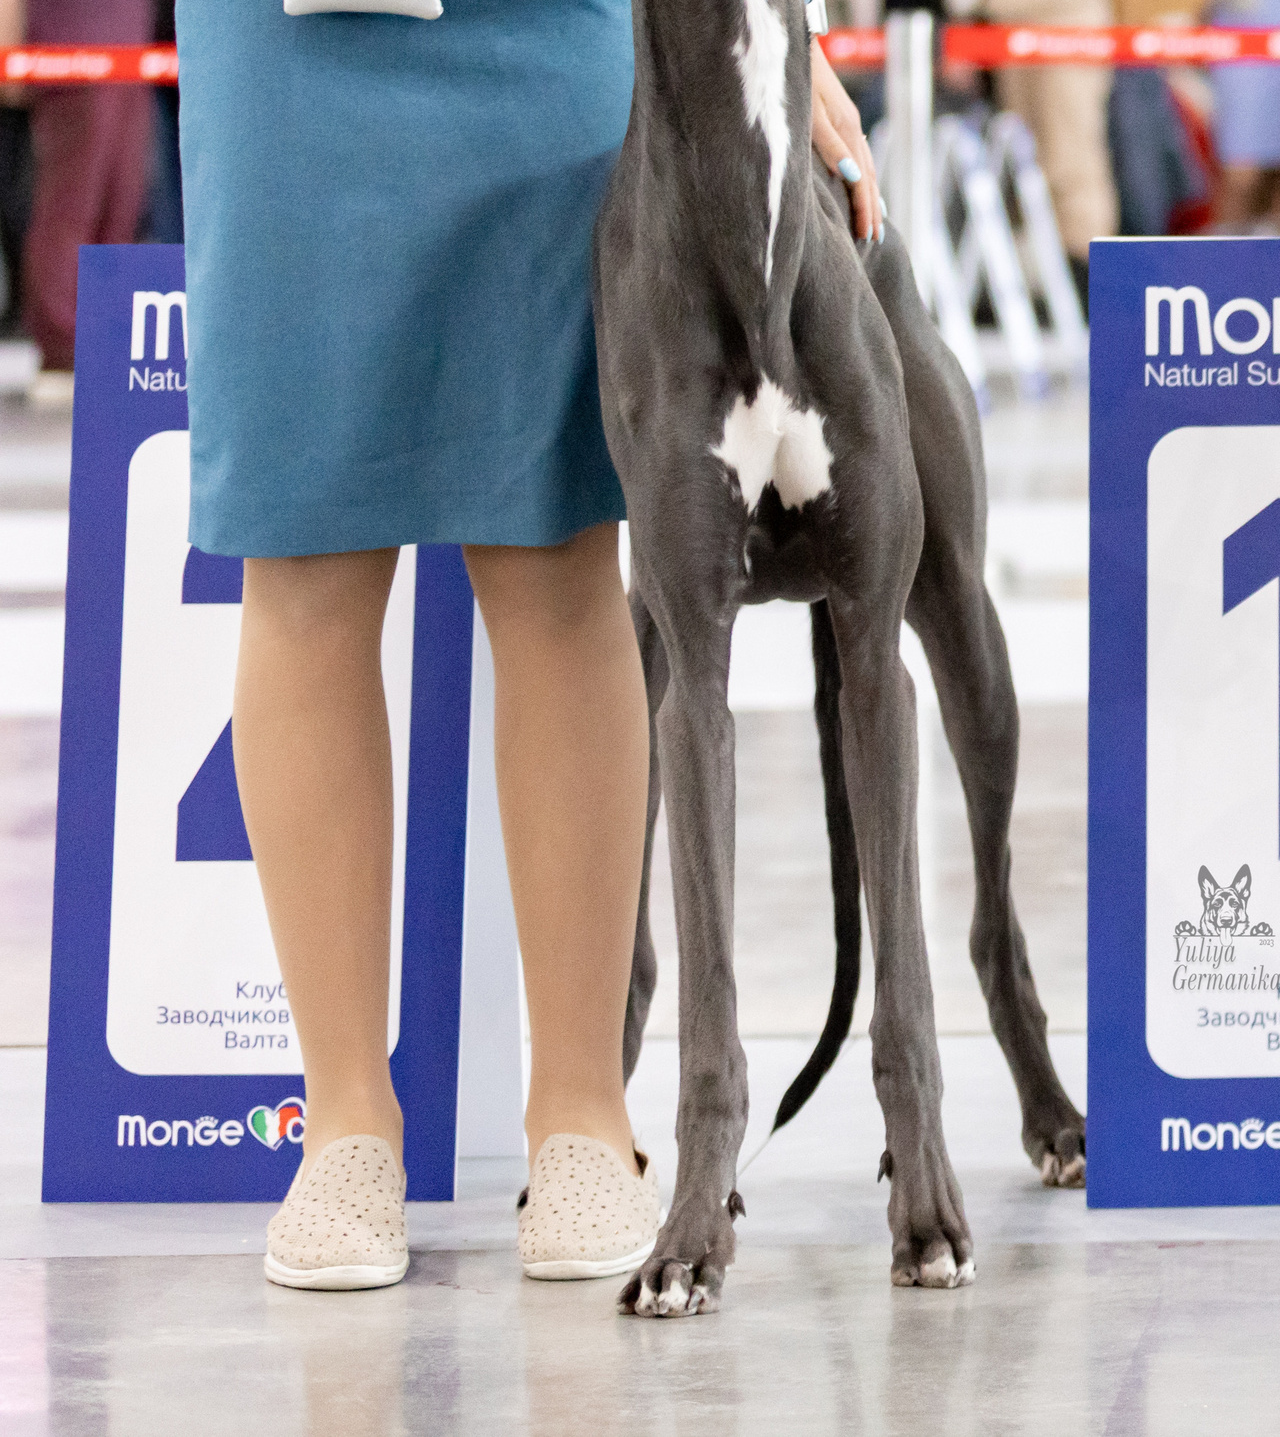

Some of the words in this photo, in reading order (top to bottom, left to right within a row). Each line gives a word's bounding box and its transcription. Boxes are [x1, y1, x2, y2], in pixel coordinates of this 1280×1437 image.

[1145, 362, 1239, 388] Natural
[156, 1005, 290, 1026] Заводчиков
[224, 1031, 289, 1049] Валта
